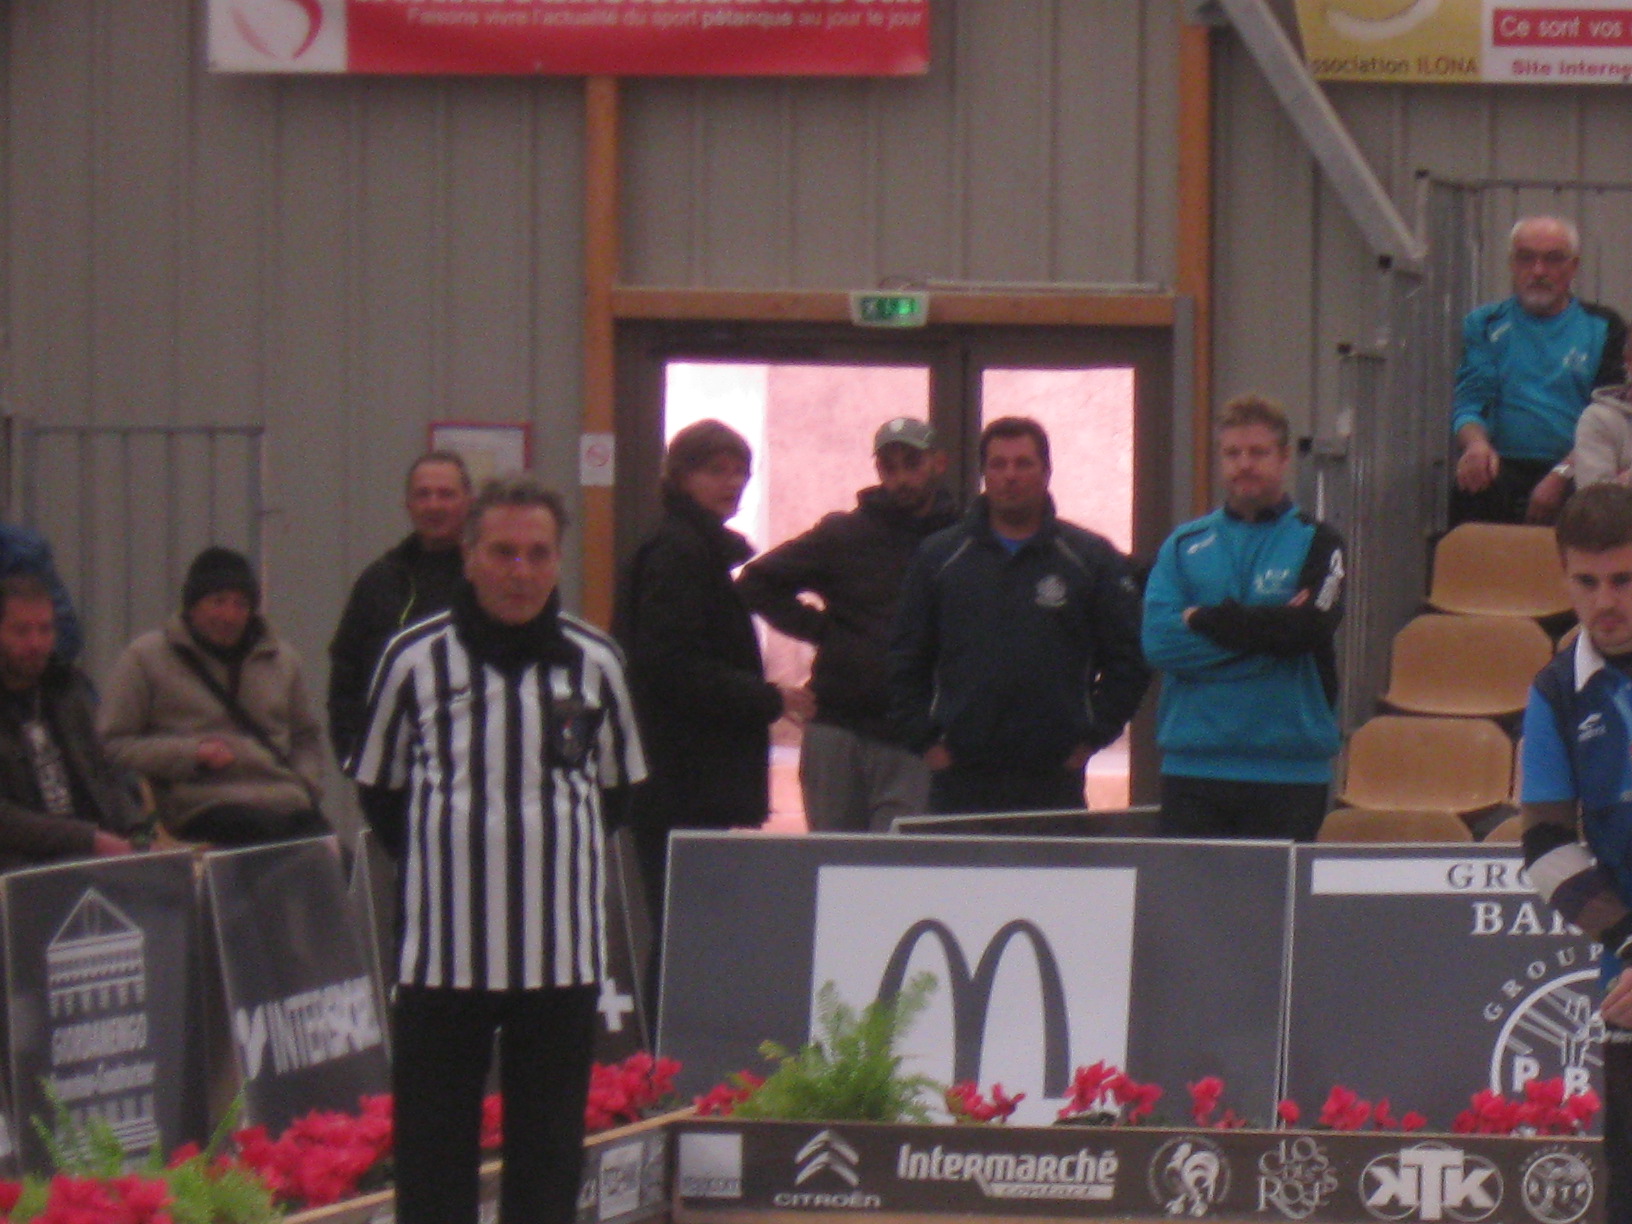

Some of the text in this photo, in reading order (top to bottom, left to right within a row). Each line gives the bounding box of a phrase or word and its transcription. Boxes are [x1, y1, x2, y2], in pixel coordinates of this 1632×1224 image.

[484, 9, 529, 25] vivre
[622, 8, 648, 25] du
[652, 9, 697, 29] sport
[701, 8, 793, 30] pétanque
[826, 9, 862, 29] jour
[866, 9, 885, 25] le
[888, 9, 922, 30] jour
[1499, 16, 1529, 37] Ce
[1538, 16, 1581, 37] sont
[1590, 20, 1623, 37] vos
[1307, 55, 1412, 76] ssociation
[1512, 59, 1551, 76] Site
